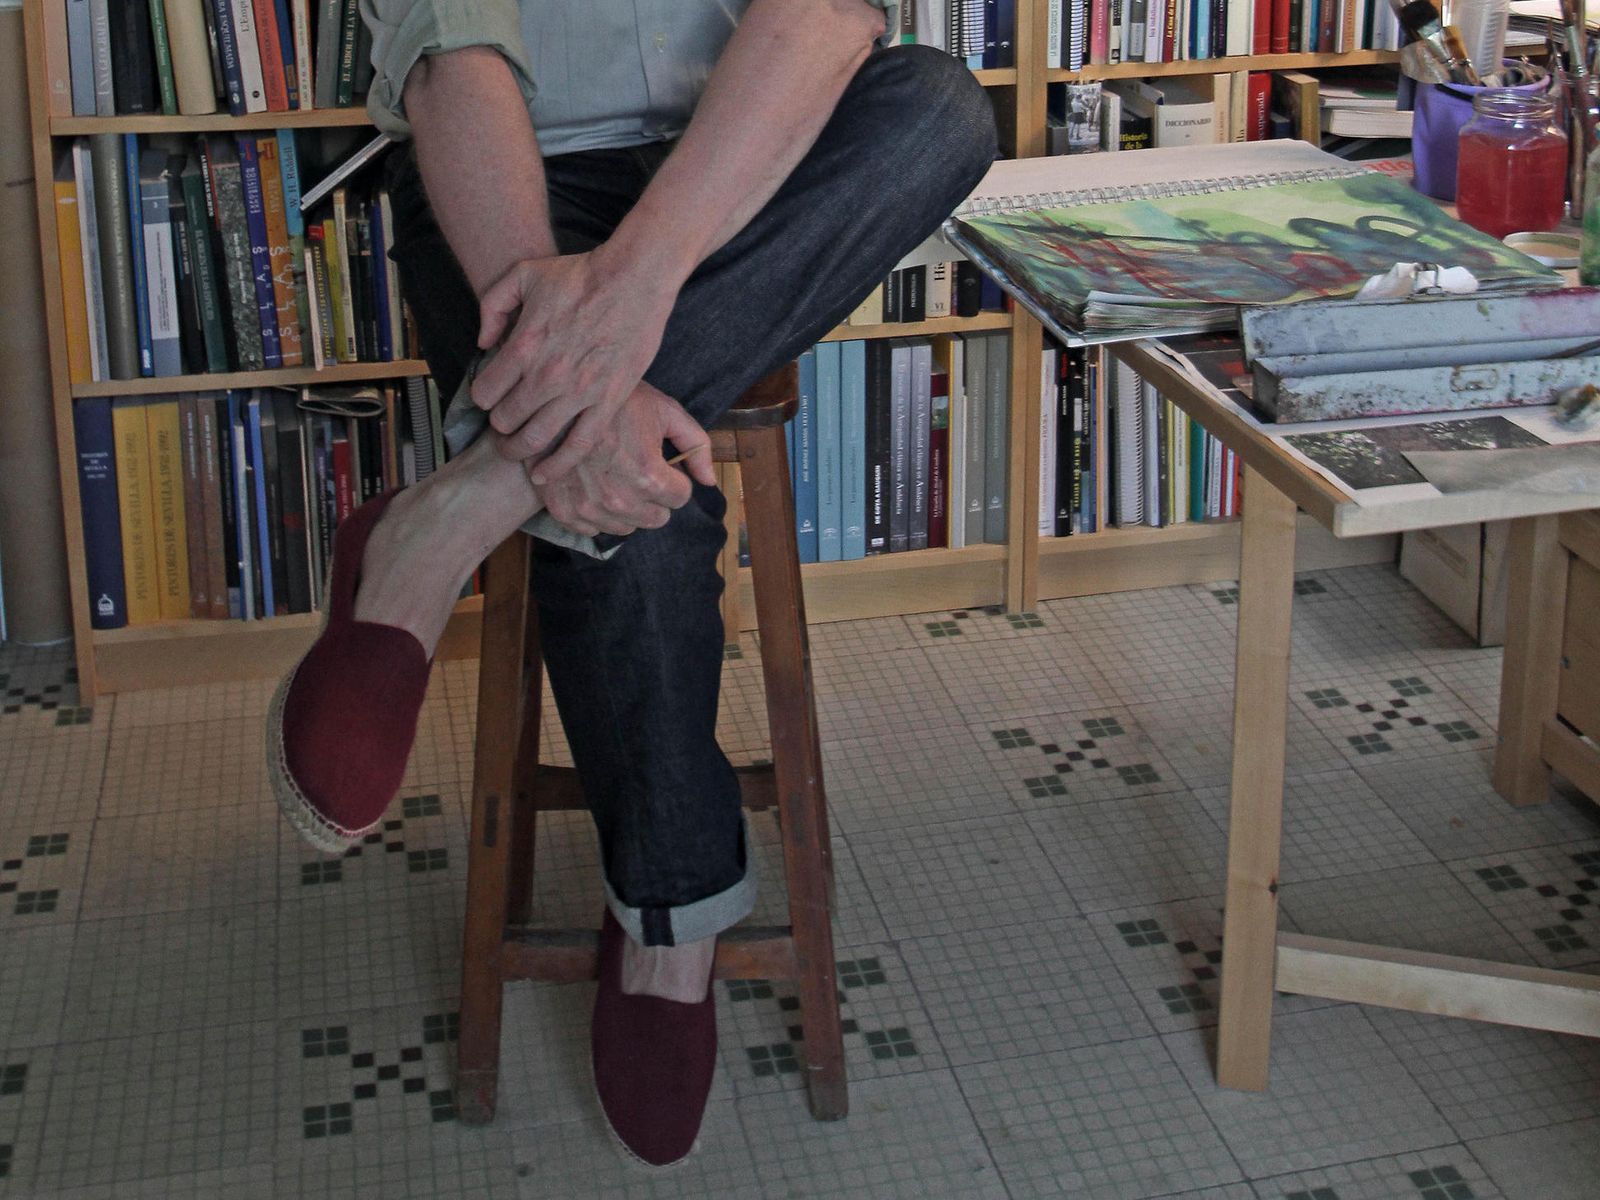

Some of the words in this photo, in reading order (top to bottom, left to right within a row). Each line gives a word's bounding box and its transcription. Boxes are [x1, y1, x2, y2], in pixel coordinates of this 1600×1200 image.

[1167, 16, 1175, 30] Casa
[346, 29, 355, 40] DE
[342, 71, 351, 82] EL
[1164, 117, 1212, 127] DICCIONARIO
[1120, 134, 1148, 142] Historia
[287, 184, 297, 194] H.
[288, 197, 298, 208] W.
[252, 246, 278, 359] ISLAS
[875, 514, 881, 524] DE
